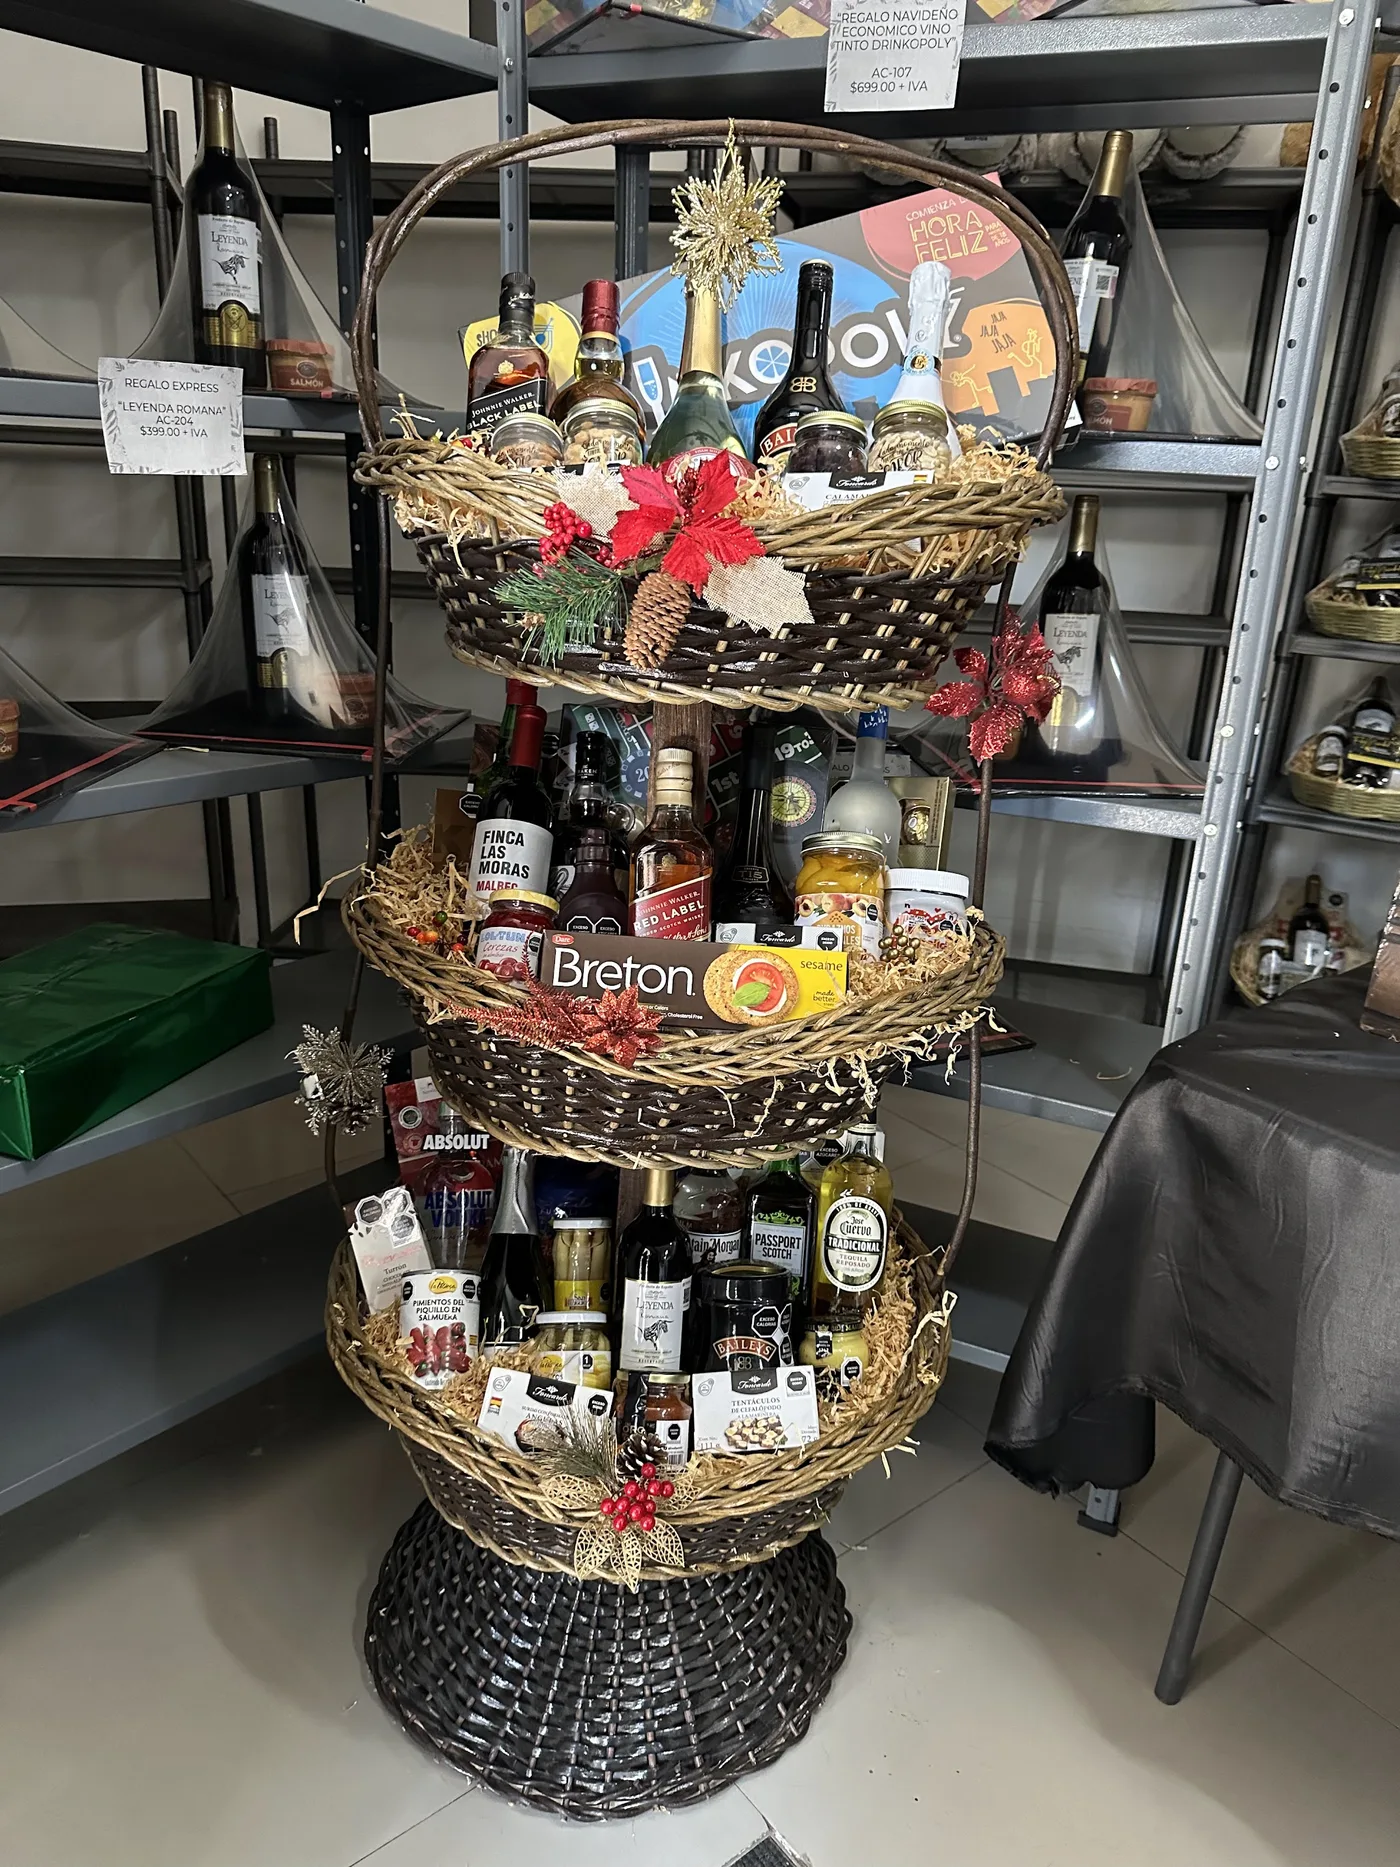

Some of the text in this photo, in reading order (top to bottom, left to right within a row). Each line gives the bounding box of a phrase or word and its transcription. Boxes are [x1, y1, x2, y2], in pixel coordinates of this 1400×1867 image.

[893, 8, 958, 22] NAVIDEÑO
[842, 24, 950, 38] ECONOMICO VINO
[834, 40, 868, 52] TINTO
[871, 67, 912, 78] AC-107
[850, 82, 896, 94] $699.00
[908, 80, 928, 92] IVA
[906, 200, 956, 222] COMIENZA
[909, 210, 983, 242] HORA
[211, 231, 248, 246] LEYENDA
[914, 230, 988, 264] FELIZ
[990, 311, 1008, 324] JAJA
[476, 328, 498, 348] SHO
[980, 324, 999, 338] JAJA
[991, 333, 1017, 354] JAJA
[124, 378, 219, 394] REGALO EXPRESS
[467, 400, 542, 430] BLACK LABEL
[472, 402, 503, 418] JOHNNIE
[156, 416, 194, 426] AC-204
[140, 426, 180, 437] $399.00
[190, 428, 208, 438] IVA
[1053, 627, 1088, 638] LEYENDA
[710, 771, 740, 793] 1st
[483, 830, 524, 847] FINCA
[481, 846, 506, 860] LAS
[478, 860, 530, 879] MORAS
[476, 880, 518, 892] MALBEC
[633, 900, 705, 932] RED LABEL
[660, 920, 682, 932] SCOTCH
[483, 942, 518, 953] Cerezas
[800, 960, 844, 972] sesame
[422, 1134, 490, 1150] ABSOLUT
[424, 1190, 492, 1210] ABSOLUT
[840, 1220, 872, 1236] Cuervo
[754, 1233, 802, 1250] PASSPORT
[828, 1236, 880, 1252] TRADICIONAL
[762, 1247, 792, 1260] SCOTCH
[840, 1254, 868, 1262] TEQUILA
[836, 1258, 871, 1268] REPOSADO
[413, 1298, 452, 1306] PIMIENTOS
[636, 1297, 674, 1310] LEYENDA
[416, 1306, 450, 1314] PIQUILLO
[716, 1339, 774, 1356] BAILEYS
[731, 1397, 781, 1406] TENTÁCULOS
